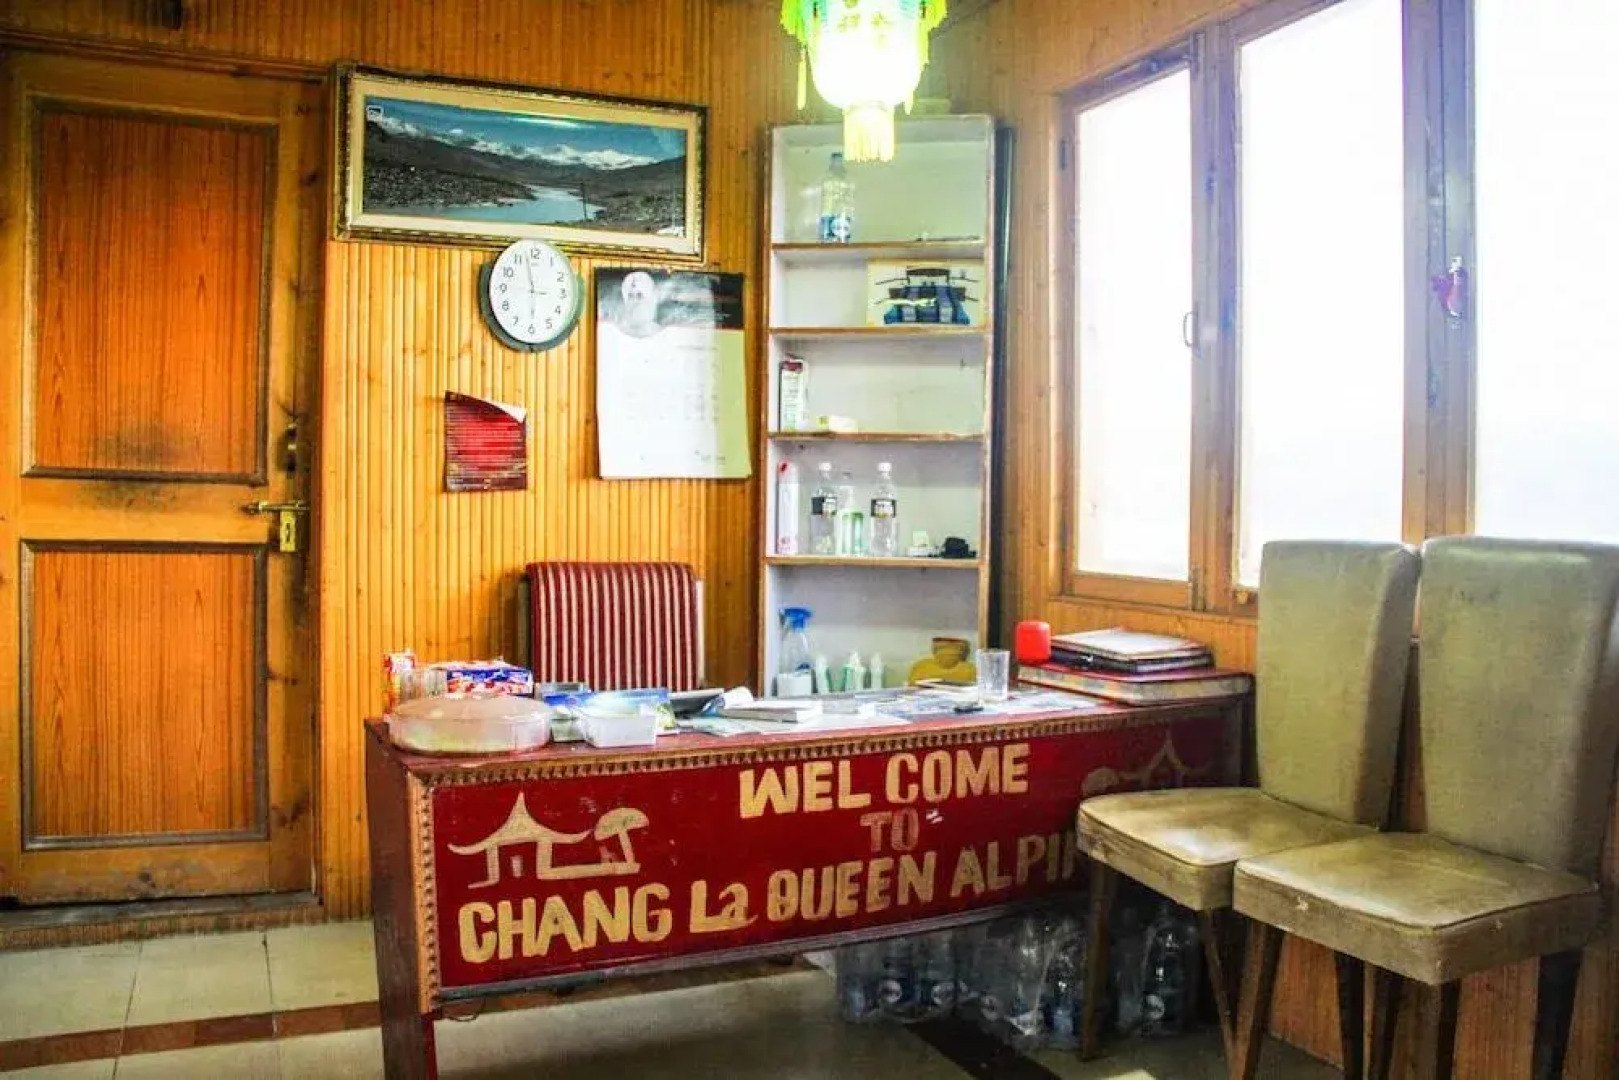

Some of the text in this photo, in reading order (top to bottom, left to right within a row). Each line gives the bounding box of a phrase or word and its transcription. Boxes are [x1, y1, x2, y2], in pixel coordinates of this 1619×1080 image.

[514, 253, 522, 264] 11
[530, 248, 540, 259] 12
[503, 266, 513, 277] 10
[557, 271, 564, 282] 2
[500, 282, 507, 293] 9
[559, 288, 566, 298] 3
[501, 300, 509, 311] 8
[554, 305, 561, 314] 4
[512, 315, 518, 326] 7
[545, 318, 552, 329] 5
[527, 323, 535, 334] 6
[860, 807, 920, 853] TO
[458, 882, 673, 963] CHANG
[689, 880, 759, 934] La
[767, 851, 937, 922] QUEEN
